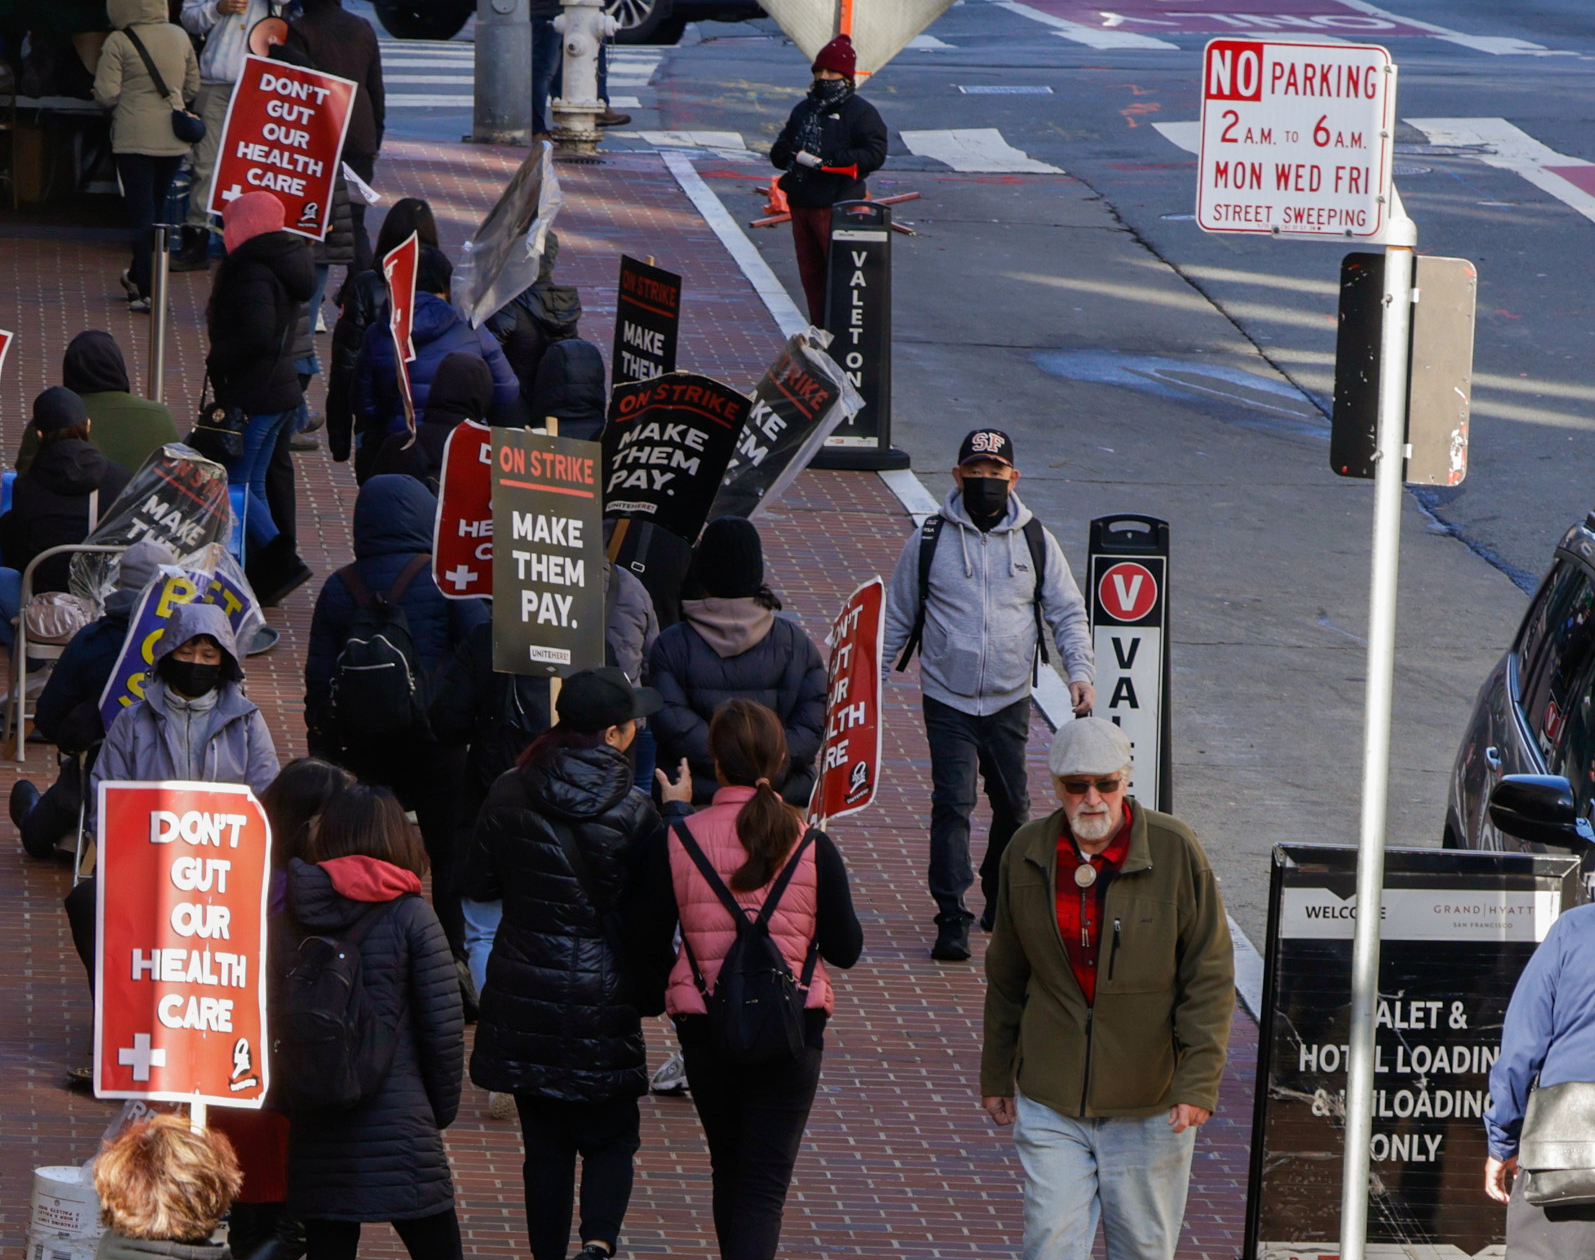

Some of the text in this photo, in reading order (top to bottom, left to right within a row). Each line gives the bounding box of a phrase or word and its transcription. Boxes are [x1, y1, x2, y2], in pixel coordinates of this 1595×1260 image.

[259, 73, 330, 106] DON'T
[1209, 49, 1377, 100] NO PARKING
[266, 100, 315, 125] GUT
[1220, 109, 1239, 143] 2
[1285, 130, 1299, 143] TO
[1313, 114, 1331, 147] 6
[262, 123, 310, 149] OUR
[236, 141, 324, 177] HEALTH
[246, 168, 307, 197] CARE
[1214, 160, 1369, 195] MON WED FRI
[1213, 203, 1273, 223] STREET
[1282, 206, 1366, 227] SWEEPING
[637, 276, 678, 308] STRIKE
[623, 320, 665, 357] MAKE
[769, 351, 831, 411] TRIKE
[619, 384, 740, 420] ON STRIKE
[618, 422, 710, 452] MAKE
[972, 432, 1005, 453] SF
[500, 445, 526, 475] ON
[530, 450, 595, 485] STRIKE
[612, 446, 701, 476] THEM
[606, 469, 676, 496] PAY.
[141, 494, 206, 547] MAKE
[511, 510, 584, 549] MAKE
[511, 550, 585, 588] THEM
[521, 589, 578, 629] PAY.
[1112, 574, 1144, 612] V
[149, 811, 247, 848] DON'T
[171, 856, 231, 894] GUT
[171, 902, 230, 940] OUR
[1434, 904, 1481, 915] GRAND
[1489, 906, 1536, 916] HYATT
[1470, 922, 1513, 930] FRANCISCO
[131, 948, 247, 988] HEALTH
[157, 994, 233, 1033] CARE
[1375, 1001, 1468, 1029] ALET &
[1299, 1044, 1501, 1074] HOTL LOADIN
[1370, 1134, 1442, 1162] ONLY
